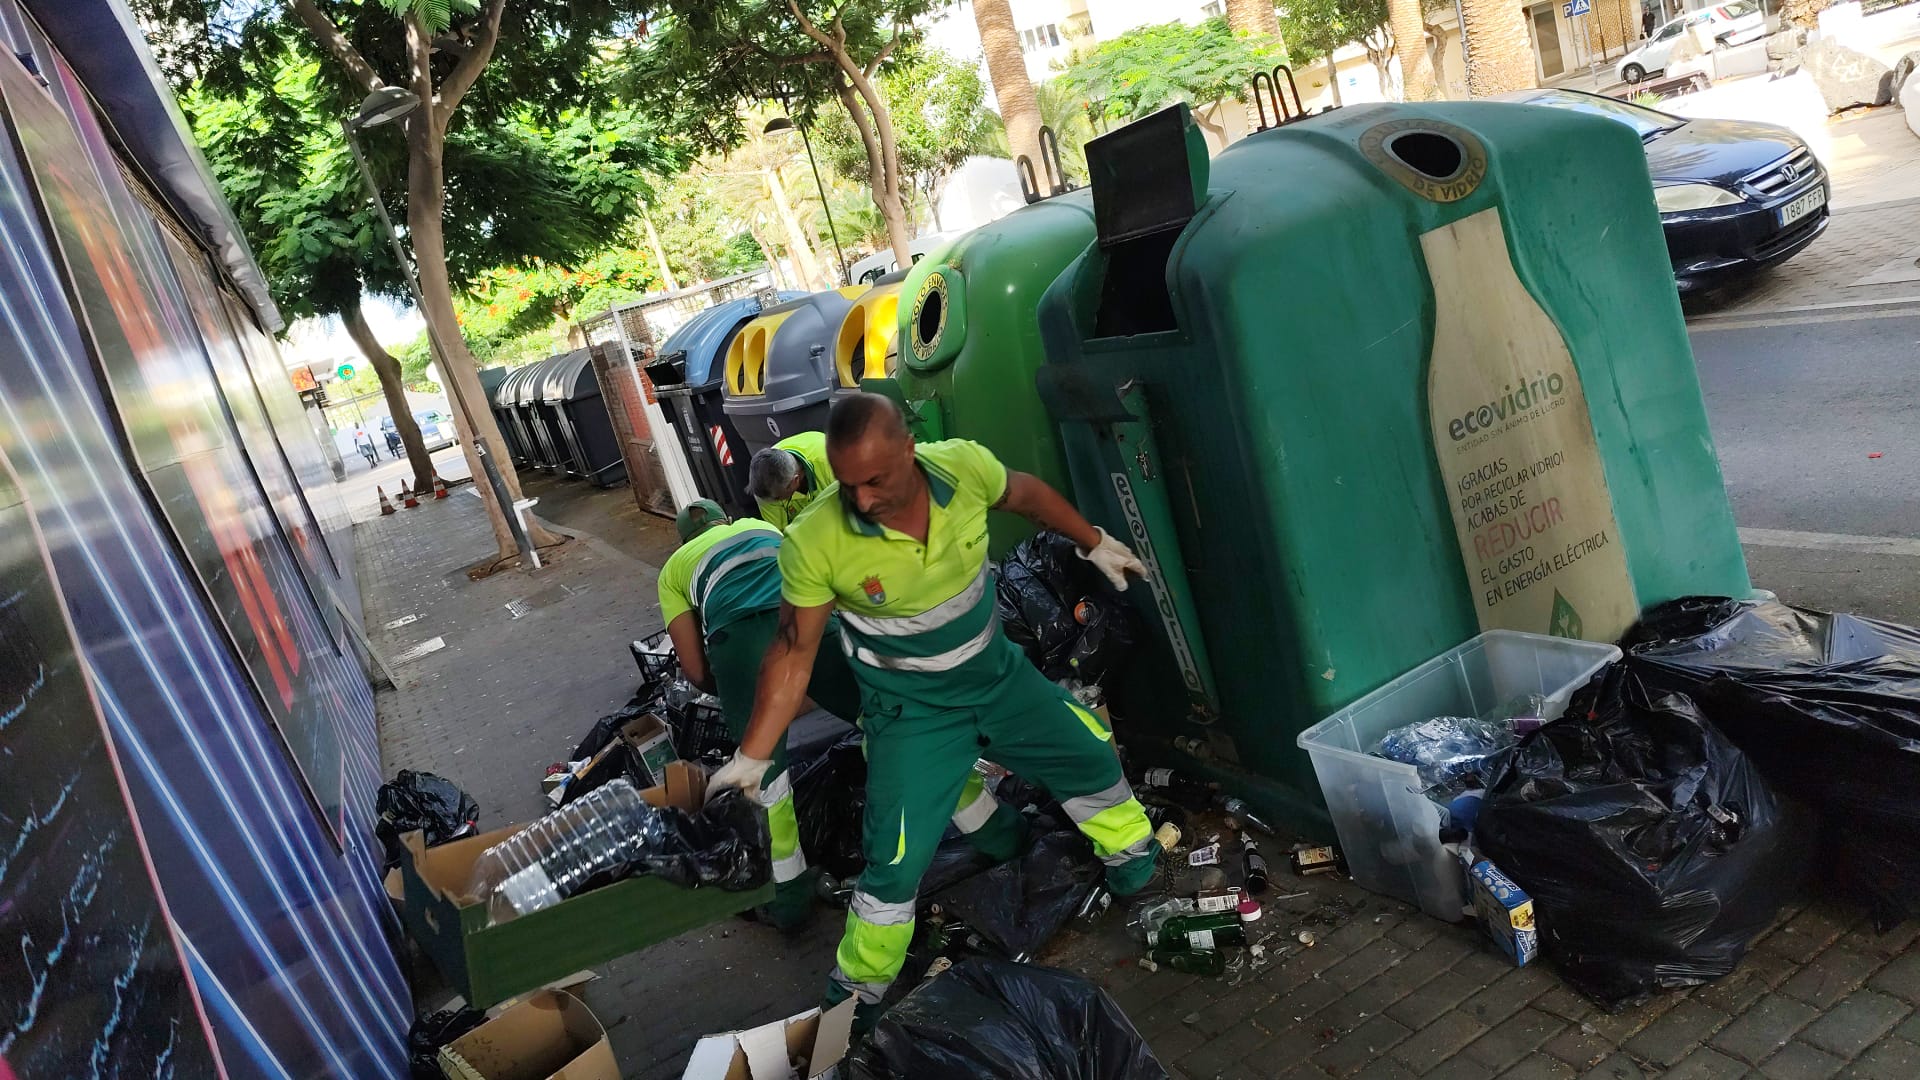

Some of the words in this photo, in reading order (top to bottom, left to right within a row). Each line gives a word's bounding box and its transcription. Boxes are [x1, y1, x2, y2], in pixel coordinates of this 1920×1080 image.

[1563, 5, 1572, 17] P
[1412, 178, 1434, 197] DE
[1441, 158, 1484, 200] VIDRIO
[1785, 198, 1805, 221] 1887
[1807, 189, 1823, 209] FFR
[1448, 370, 1564, 441] ecovidrio
[1456, 433, 1489, 455] ENTIDAD
[1491, 426, 1504, 439] SIN
[1530, 409, 1541, 420] DE
[1541, 397, 1566, 415] LUCRO
[1457, 457, 1508, 496] ¡GRACIAS
[1461, 492, 1483, 512] POR
[1483, 468, 1530, 501] RECICLAR
[1530, 450, 1565, 477] VIDRIO!
[1467, 500, 1508, 533] ACABAS
[1510, 489, 1527, 510] DE
[1473, 496, 1564, 563] REDUCIR
[1480, 567, 1497, 585] EL
[1498, 546, 1534, 575] GASTO
[1486, 586, 1503, 607] EN
[1504, 559, 1553, 597] ENERGÍA
[1553, 530, 1609, 571] ELÉCTRICA
